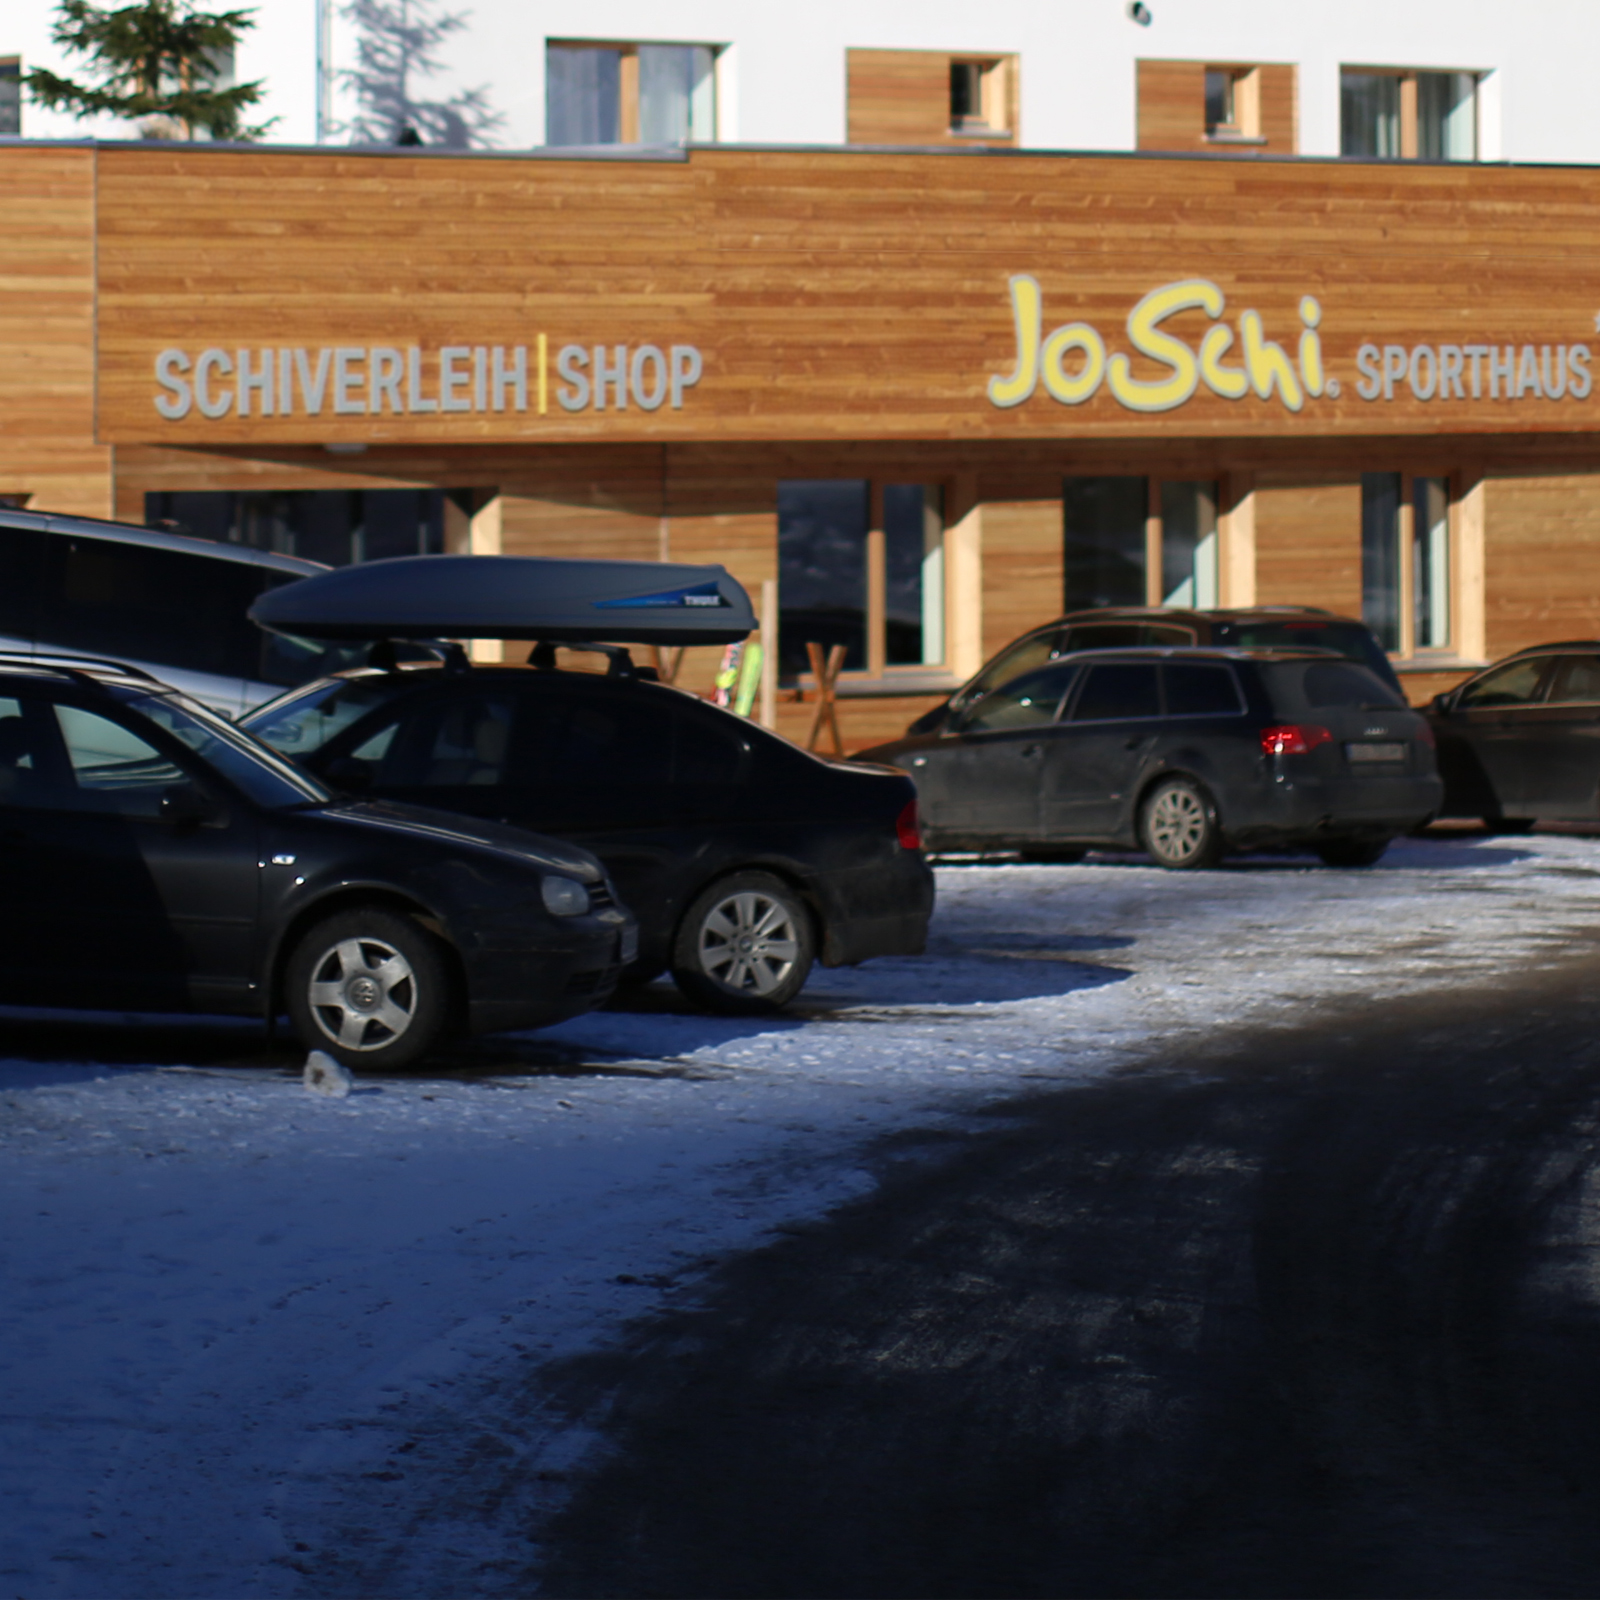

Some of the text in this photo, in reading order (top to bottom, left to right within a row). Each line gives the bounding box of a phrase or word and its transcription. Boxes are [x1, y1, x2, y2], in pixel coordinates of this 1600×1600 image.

[154, 344, 702, 419] SCHIVERLEIH SHOP
[989, 275, 1592, 411] JoSchi SPORTHAUS
